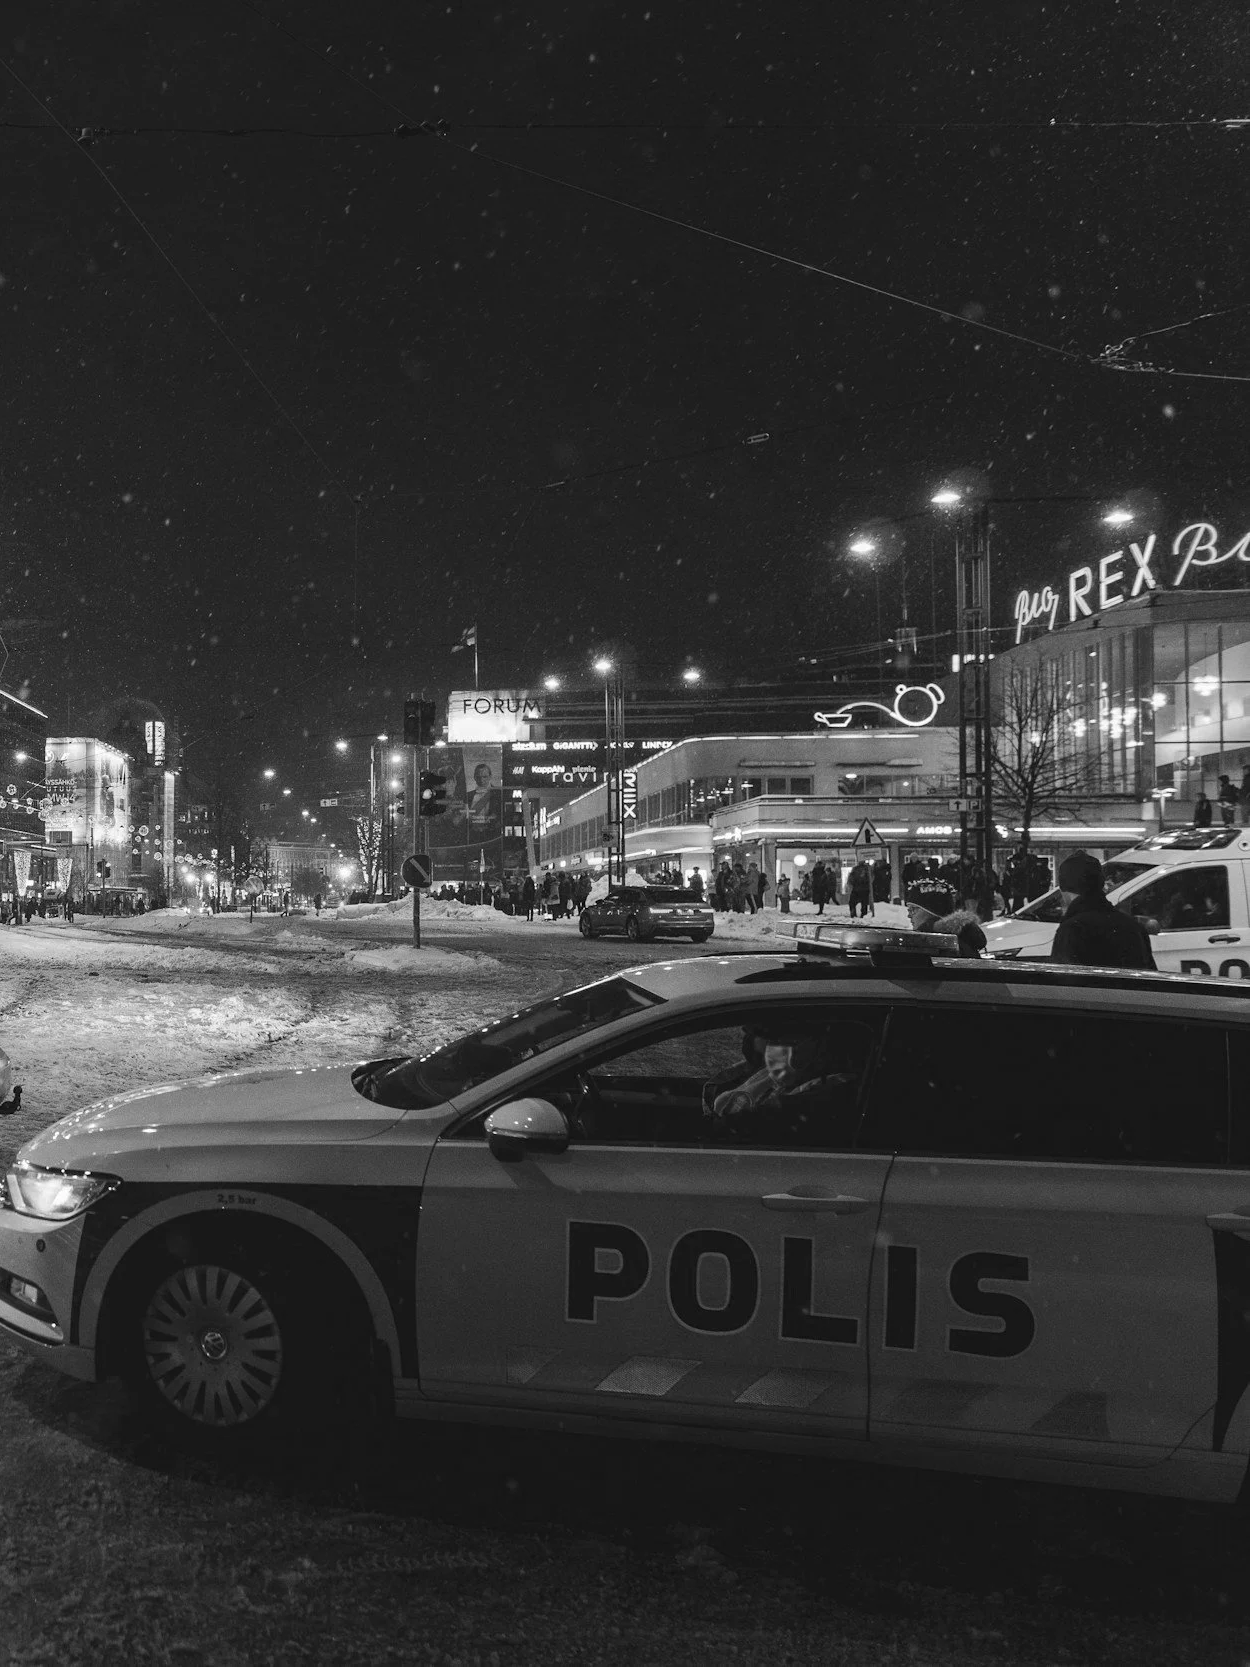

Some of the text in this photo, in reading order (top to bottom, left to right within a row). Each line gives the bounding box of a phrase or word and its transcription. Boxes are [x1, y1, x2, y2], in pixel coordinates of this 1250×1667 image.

[1069, 534, 1156, 621] REX
[463, 698, 541, 714] FORUM
[916, 825, 952, 834] AMOS
[238, 1194, 256, 1205] bar
[566, 1220, 1036, 1359] POLIS
